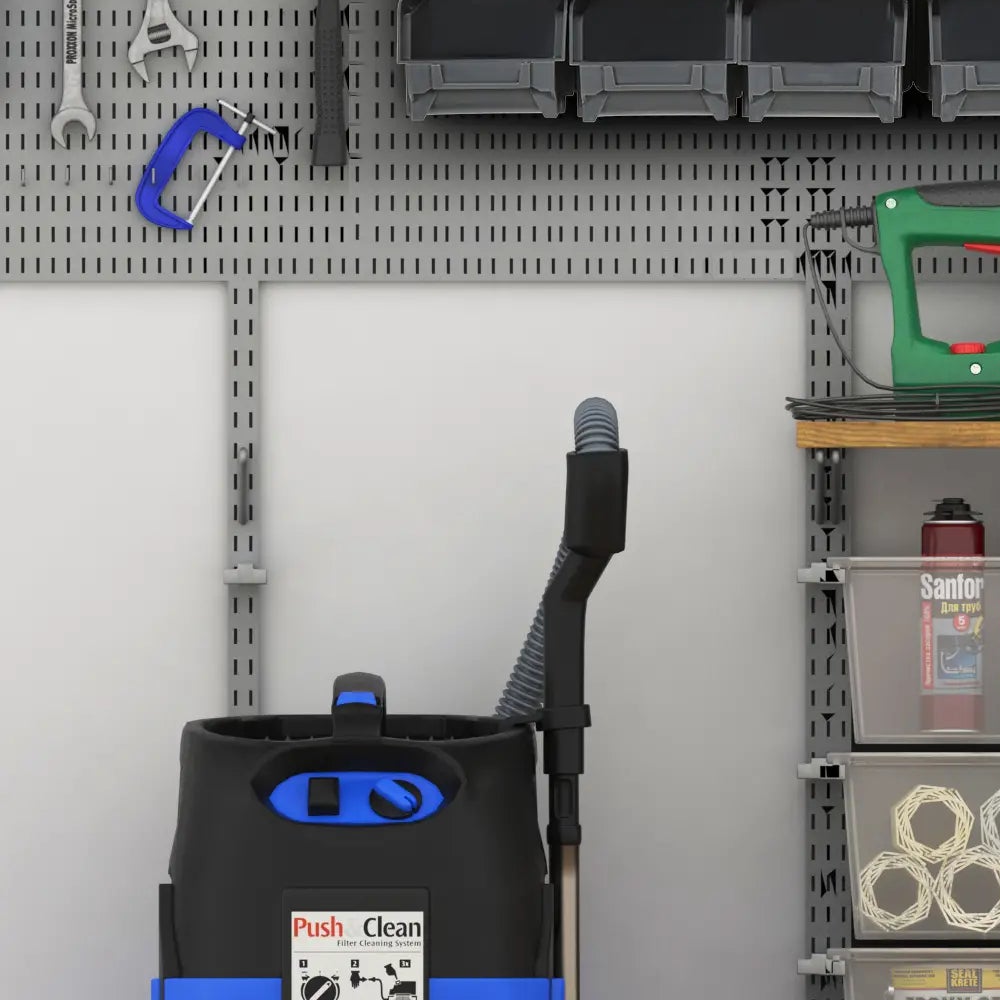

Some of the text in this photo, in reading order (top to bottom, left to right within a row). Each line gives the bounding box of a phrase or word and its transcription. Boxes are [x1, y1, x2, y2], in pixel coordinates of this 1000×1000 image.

[66, 32, 77, 64] PROXXON
[920, 573, 984, 600] Sanfor
[940, 602, 958, 614] Для
[294, 916, 421, 938] Push Clean
[360, 940, 393, 948] Cleaning
[395, 940, 422, 948] System
[951, 969, 977, 978] SEAL
[951, 978, 978, 987] KRETE
